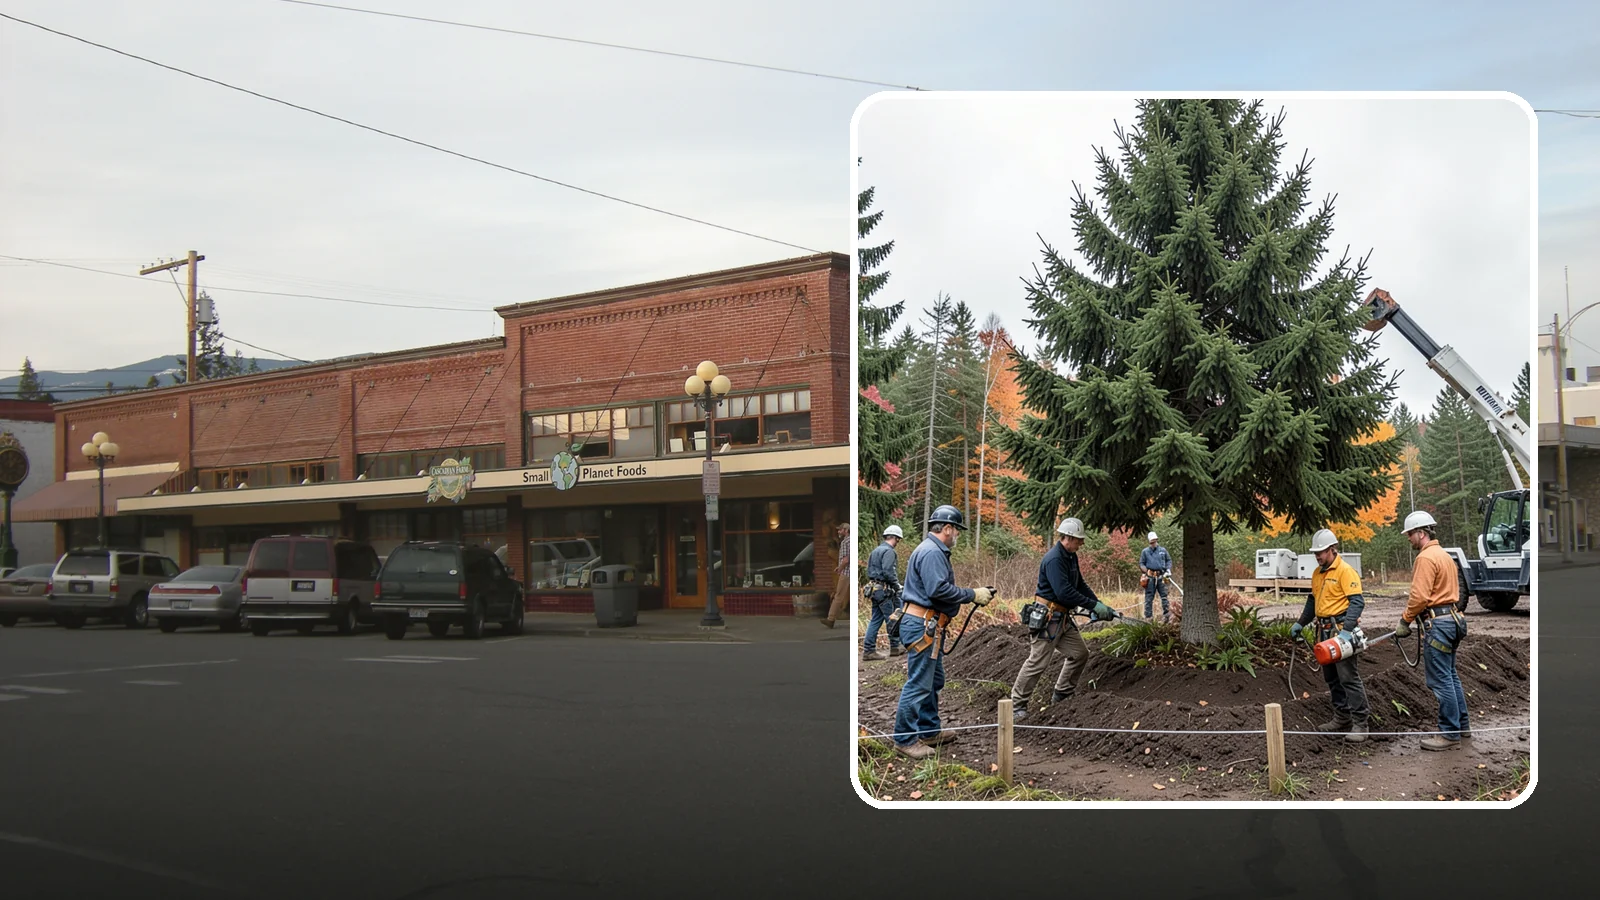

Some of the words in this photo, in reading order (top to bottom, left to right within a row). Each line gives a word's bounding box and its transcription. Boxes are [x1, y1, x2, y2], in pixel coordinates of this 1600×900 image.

[523, 471, 549, 483] Small
[582, 467, 614, 479] Planet
[616, 464, 647, 477] Foods
